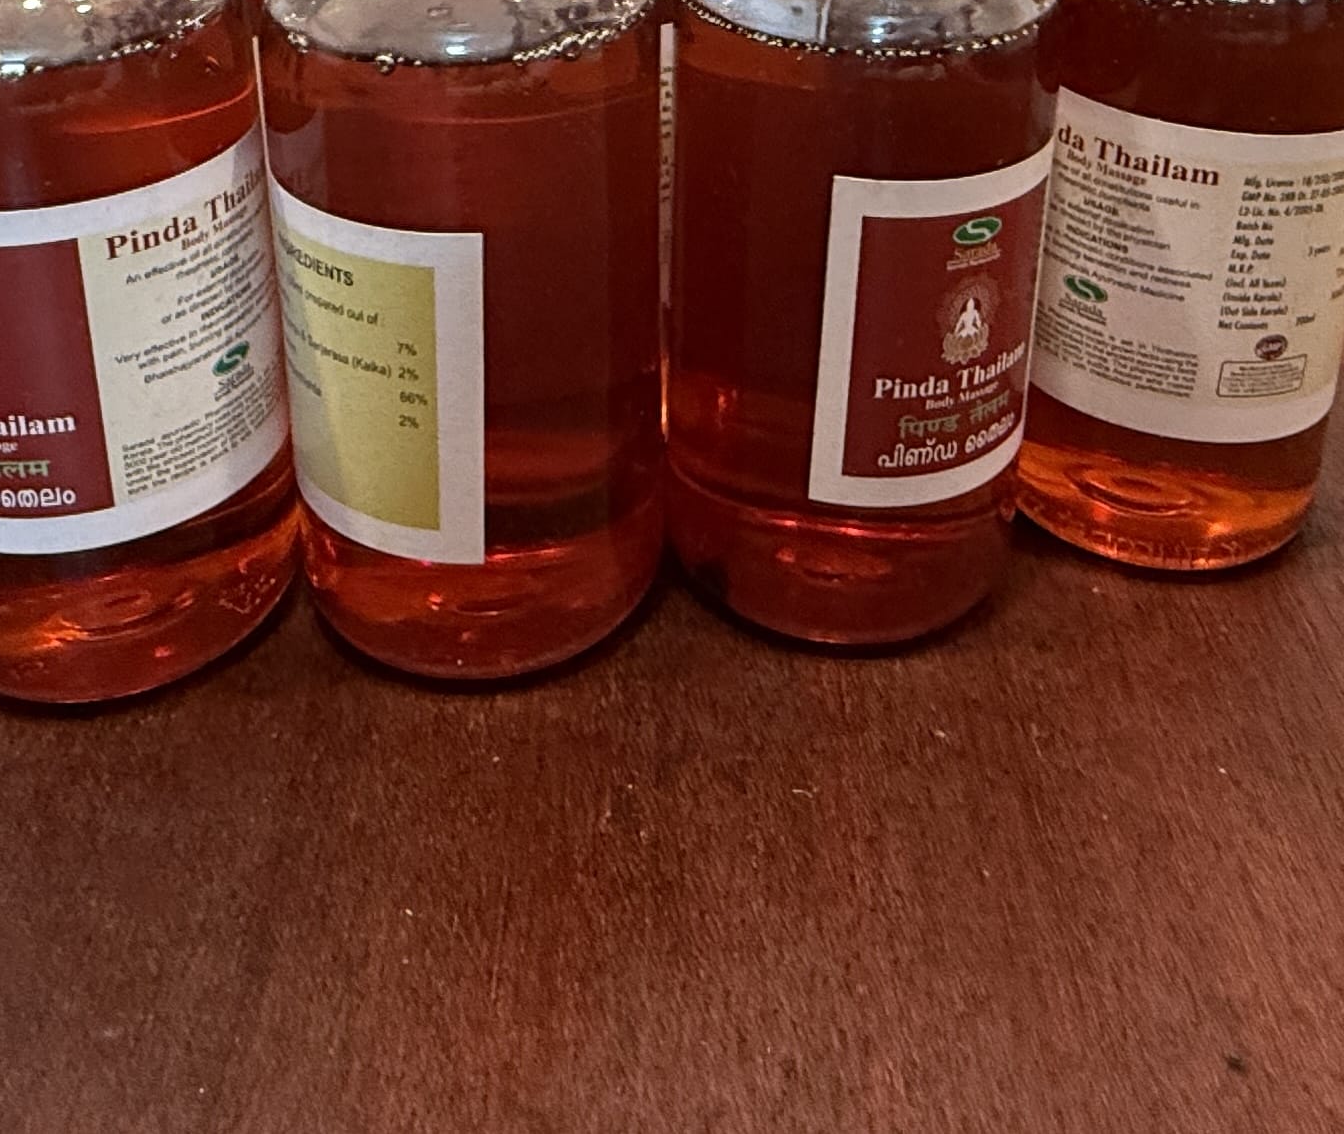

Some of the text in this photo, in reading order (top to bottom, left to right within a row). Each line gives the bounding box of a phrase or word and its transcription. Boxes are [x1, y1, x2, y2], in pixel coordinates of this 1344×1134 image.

[1094, 136, 1219, 186] Thailam
[105, 215, 198, 261] Pinda
[398, 367, 419, 381] 2%
[873, 375, 950, 399] Pinda
[956, 340, 1025, 390] Thailam
[398, 414, 419, 430] 2%
